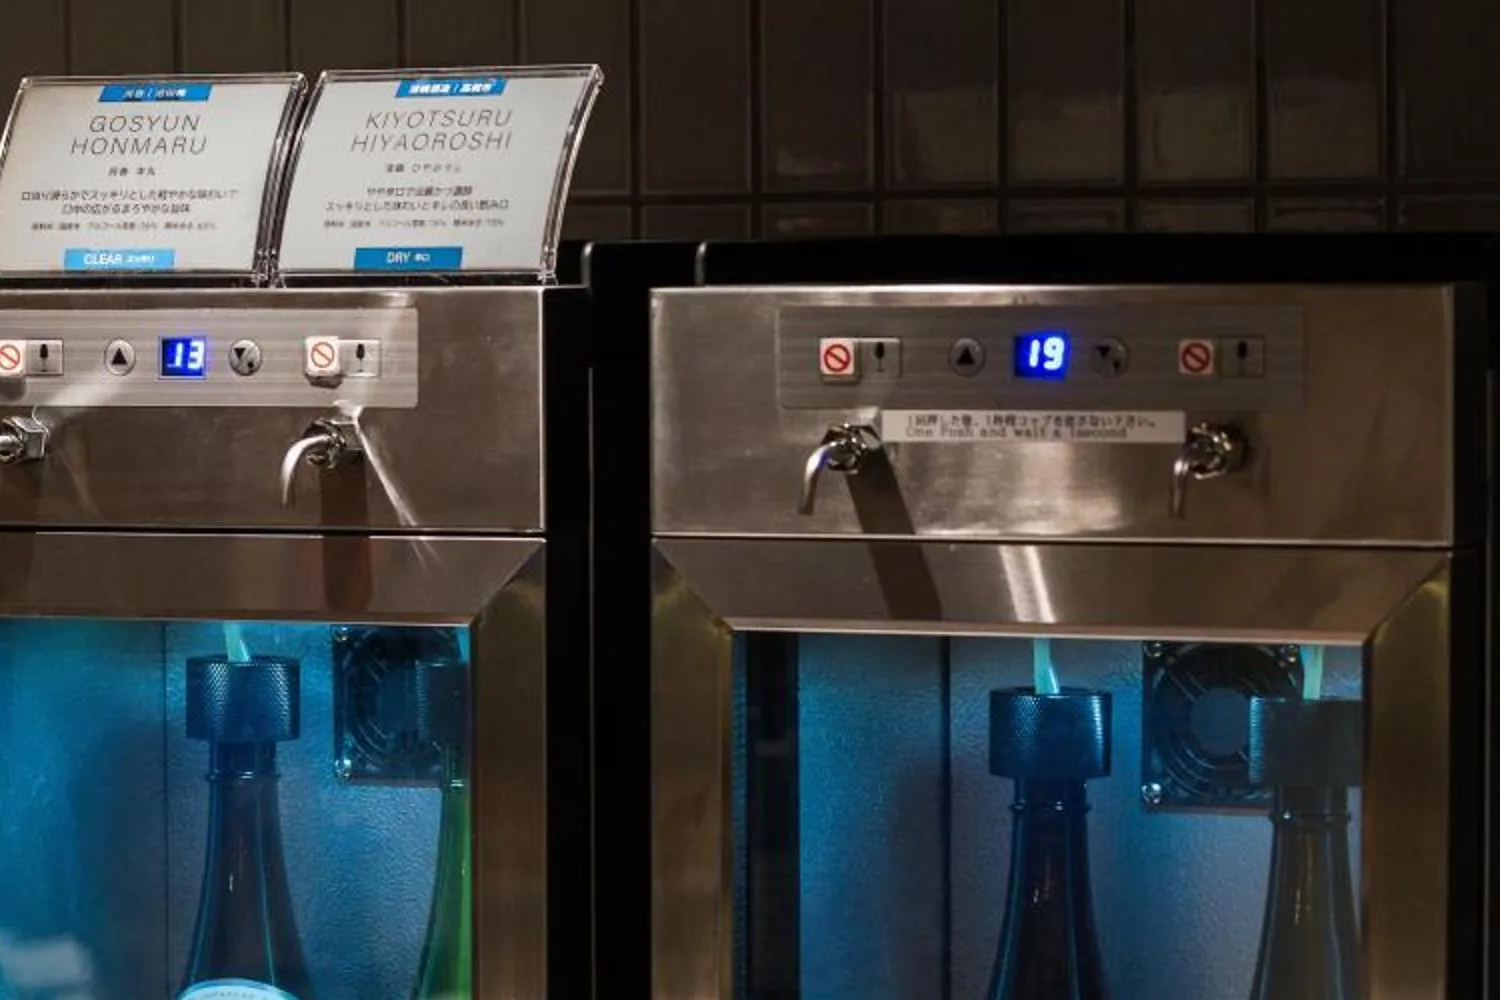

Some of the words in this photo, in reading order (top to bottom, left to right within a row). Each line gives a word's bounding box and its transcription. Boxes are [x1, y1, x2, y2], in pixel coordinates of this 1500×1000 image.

[89, 114, 201, 133] GOSYUN
[365, 109, 513, 129] KIYOTSURU
[70, 136, 207, 156] HONMARU
[351, 132, 512, 152] HIYAOROSHI
[83, 253, 123, 266] CLEAR
[386, 251, 411, 264] DRY
[171, 340, 204, 369] 13
[1028, 337, 1065, 371] 19
